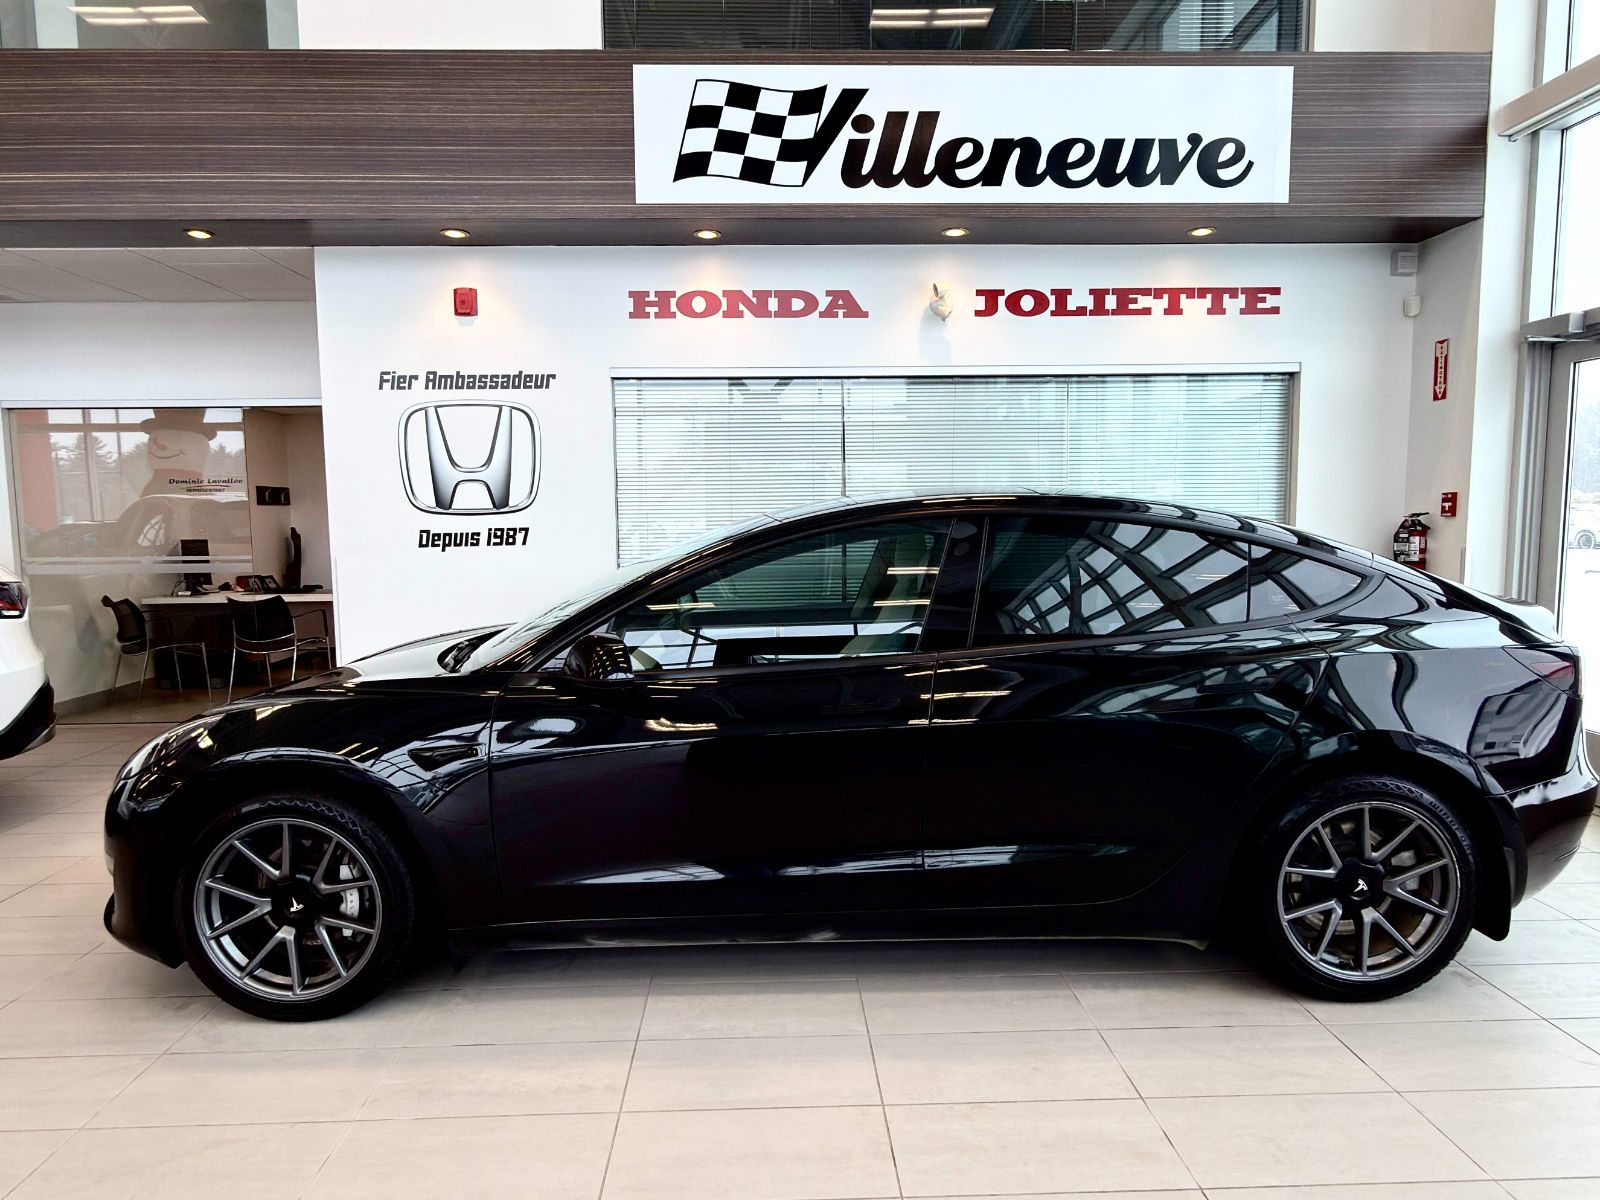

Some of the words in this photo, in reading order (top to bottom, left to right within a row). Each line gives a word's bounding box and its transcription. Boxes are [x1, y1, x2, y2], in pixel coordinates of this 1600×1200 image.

[788, 84, 1254, 189] Villeneuve
[628, 289, 868, 319] HONDA
[974, 286, 1281, 317] JOLIETTE
[378, 371, 418, 391] Fier
[424, 370, 557, 391] Ambassadeur
[418, 529, 481, 552] Depuis
[486, 527, 530, 547] 1987
